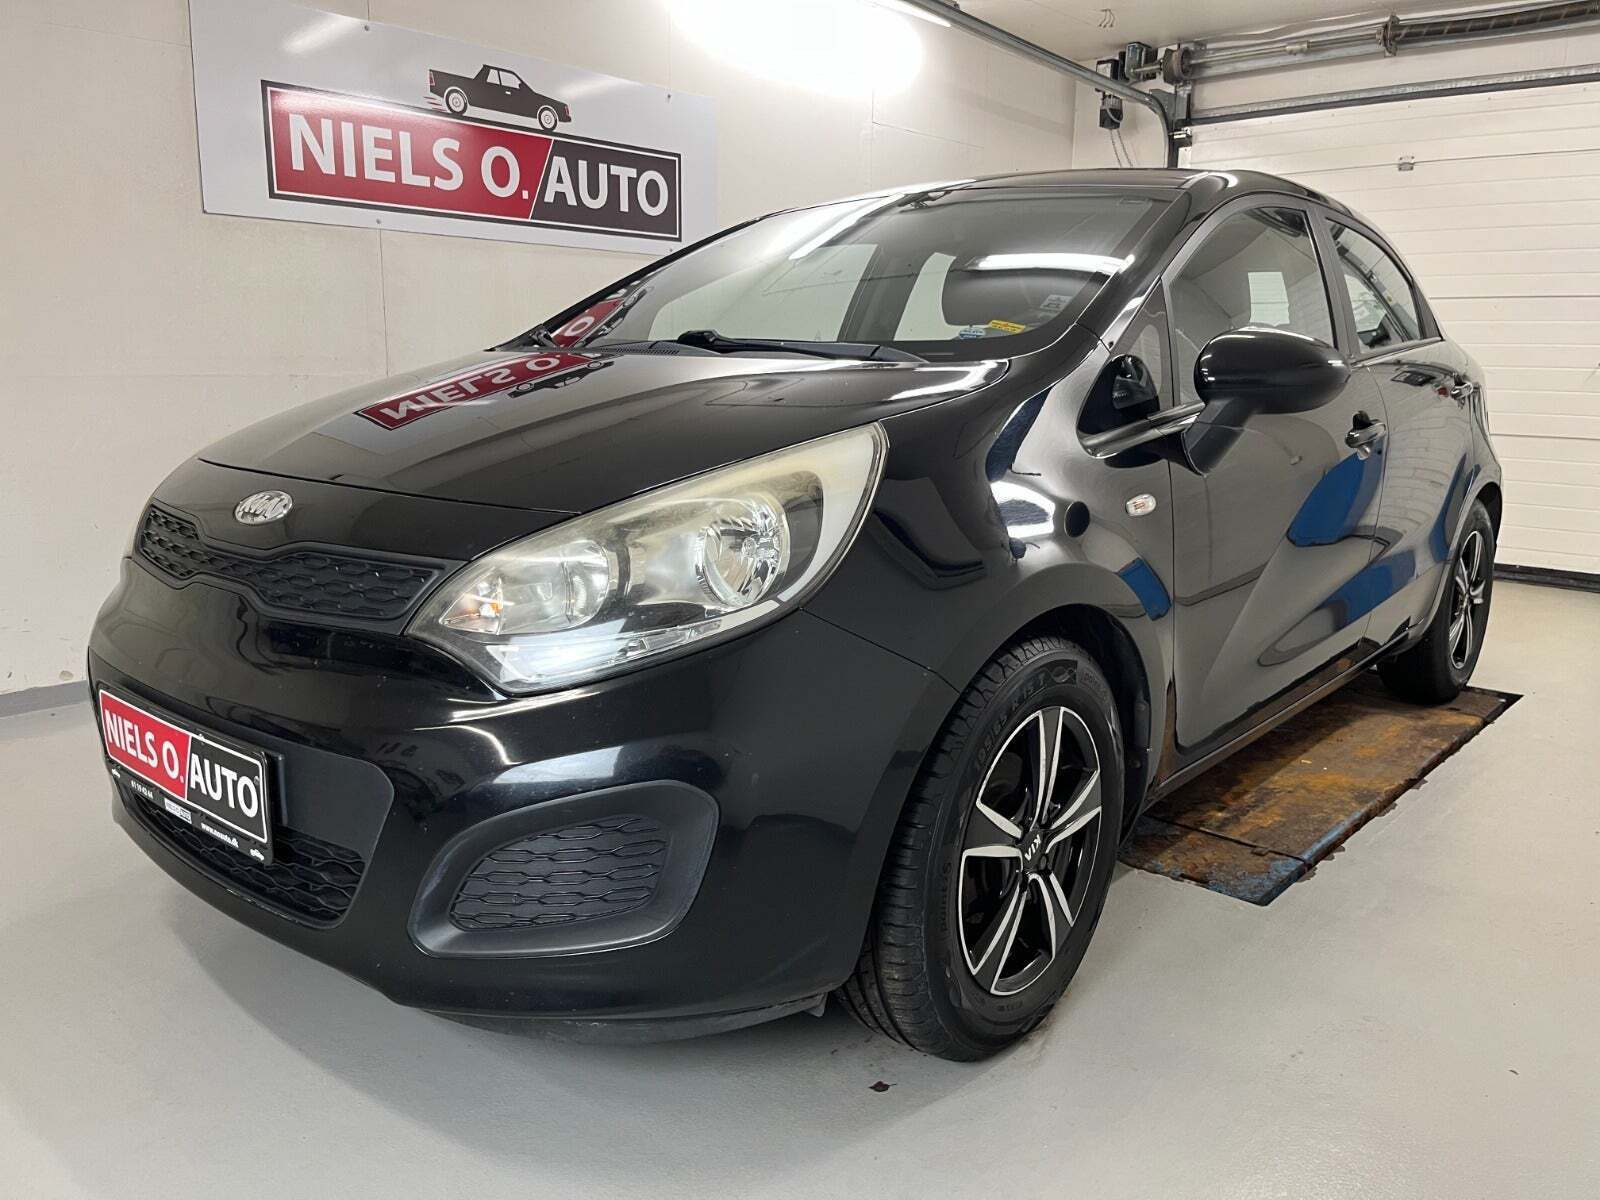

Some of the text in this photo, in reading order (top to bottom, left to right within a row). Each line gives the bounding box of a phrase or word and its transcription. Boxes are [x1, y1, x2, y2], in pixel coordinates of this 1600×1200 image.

[288, 113, 669, 217] NIELS O. AUTO
[105, 708, 158, 768] NIELS
[162, 740, 184, 784] O.
[190, 752, 258, 818] AUTO
[1024, 834, 1041, 861] KIA
